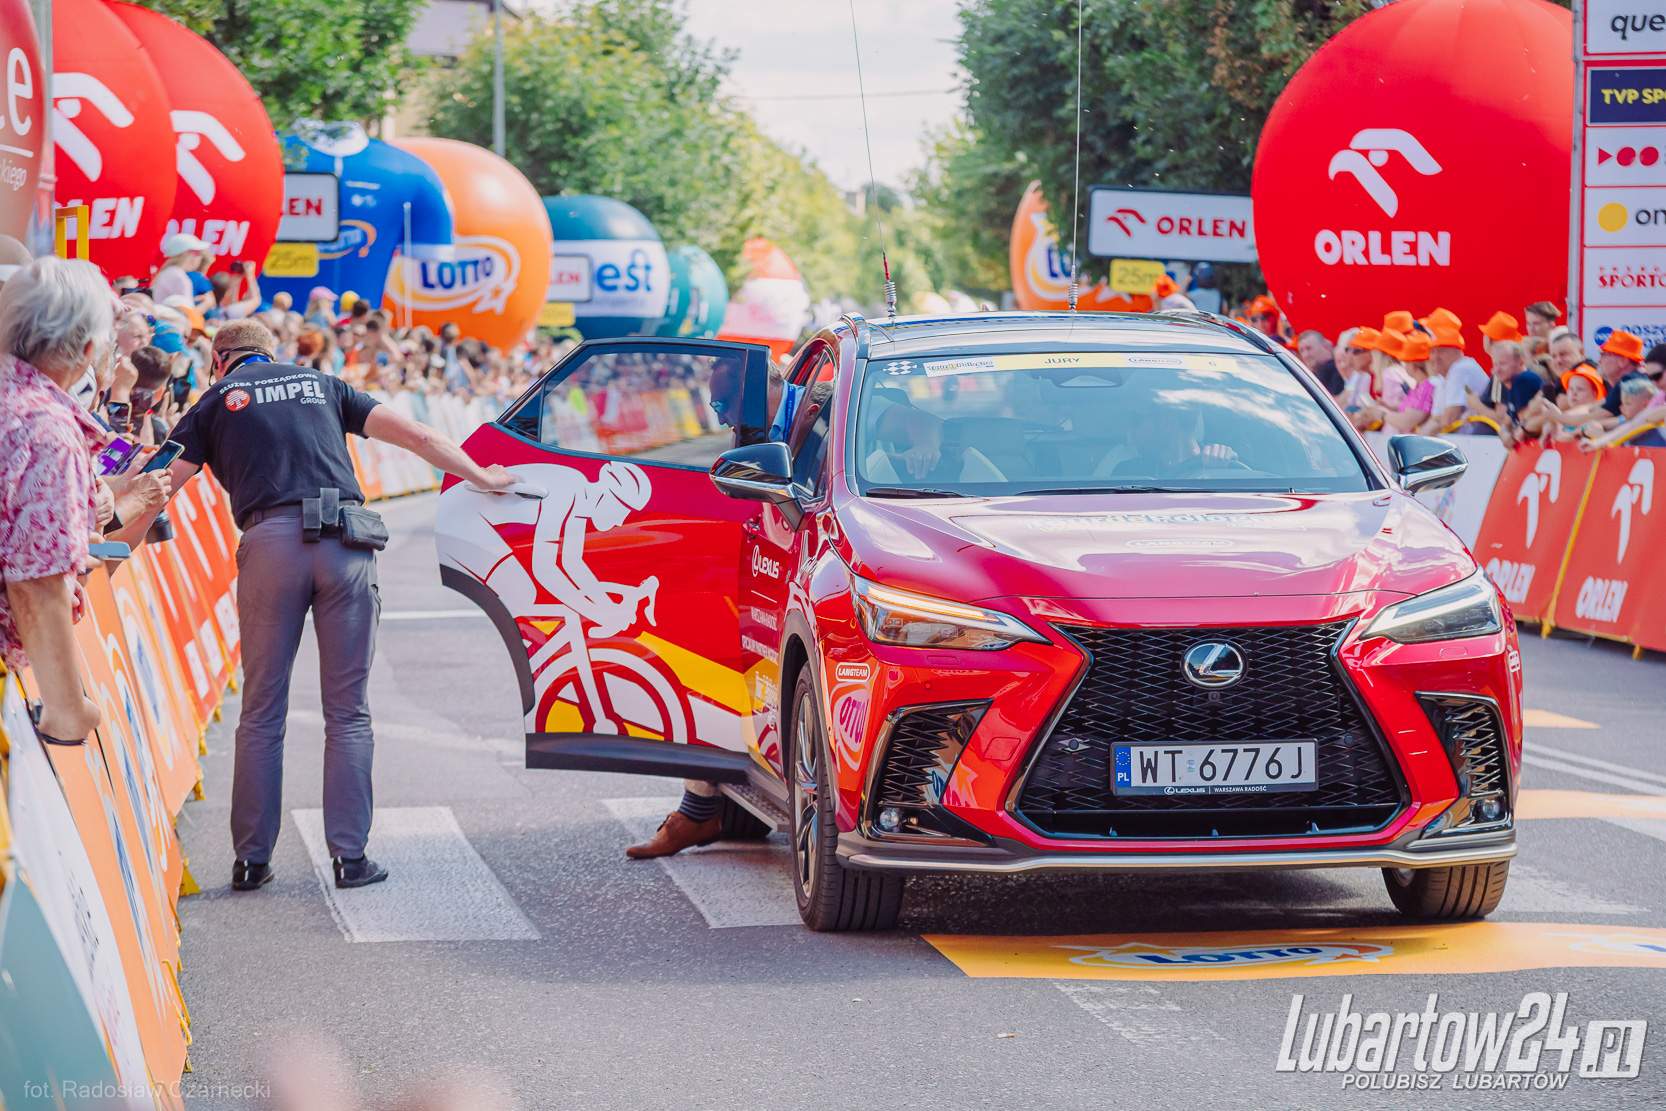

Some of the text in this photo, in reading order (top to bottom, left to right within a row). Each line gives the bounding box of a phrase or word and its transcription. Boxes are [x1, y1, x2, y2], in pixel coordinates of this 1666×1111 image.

[1601, 88, 1666, 105] TVP SP
[280, 197, 323, 216] EN
[1156, 216, 1247, 239] ORLEN
[1314, 229, 1451, 267] ORLEN
[420, 257, 495, 289] LOTTO
[1045, 357, 1080, 365] JURY
[255, 380, 325, 404] IMPEL
[300, 397, 327, 405] GROUP
[758, 556, 780, 579] LEXUS
[838, 667, 868, 678] LANGTEAM
[1139, 747, 1304, 783] WT 6776J
[1117, 772, 1130, 782] PL
[1214, 785, 1243, 793] WARSZAWA
[1136, 947, 1323, 964] LOTTO
